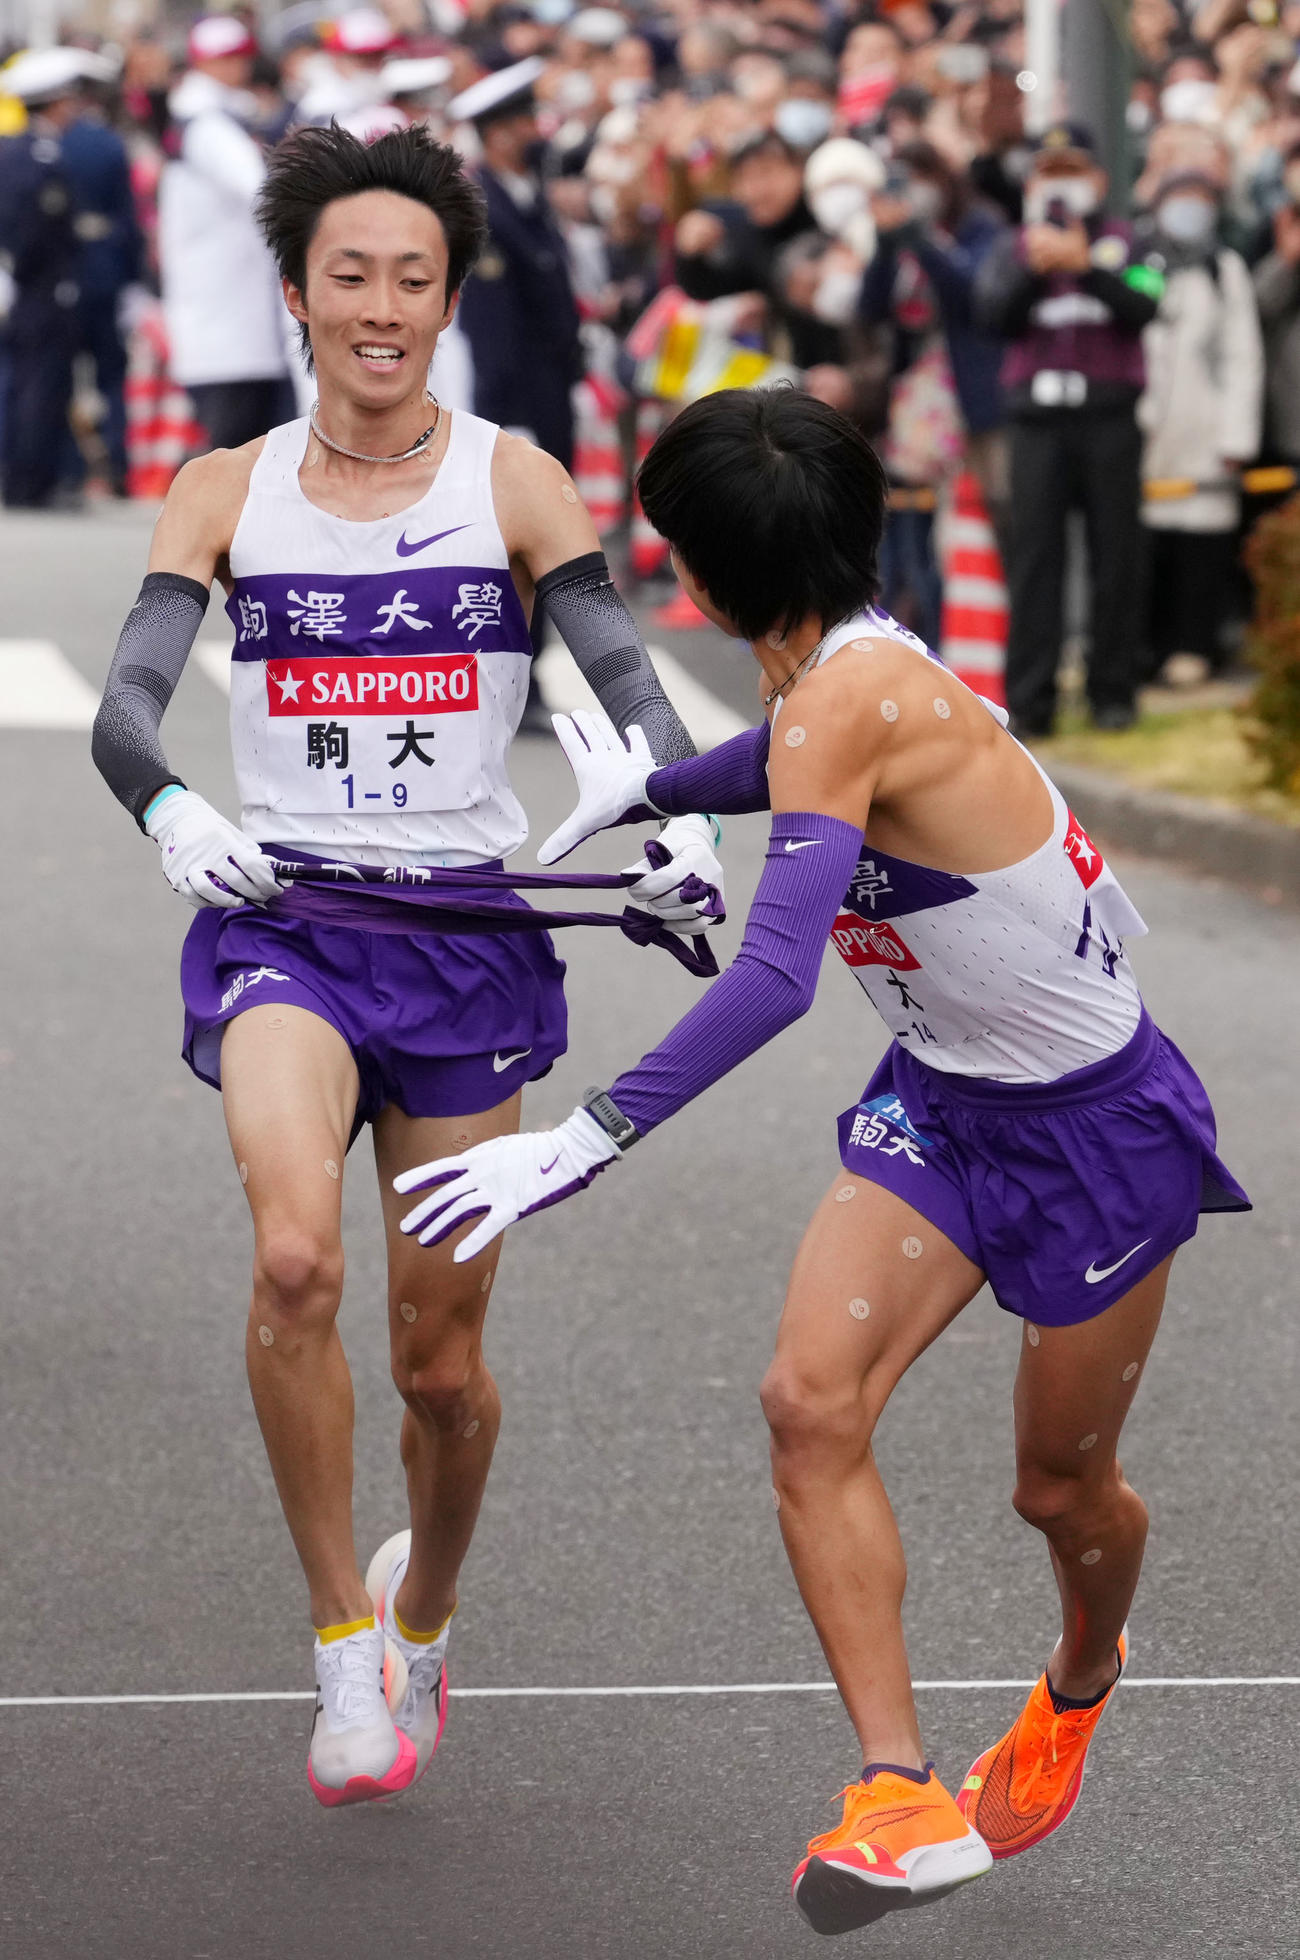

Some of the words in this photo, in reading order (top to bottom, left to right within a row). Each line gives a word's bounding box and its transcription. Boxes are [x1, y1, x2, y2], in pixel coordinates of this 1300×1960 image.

[238, 581, 503, 643] 駒澤大學
[311, 668, 470, 704] SAPPORO
[307, 720, 436, 770] 駒大
[341, 773, 408, 809] 1-9
[896, 1021, 938, 1044] -14
[848, 1113, 926, 1168] 駒大
